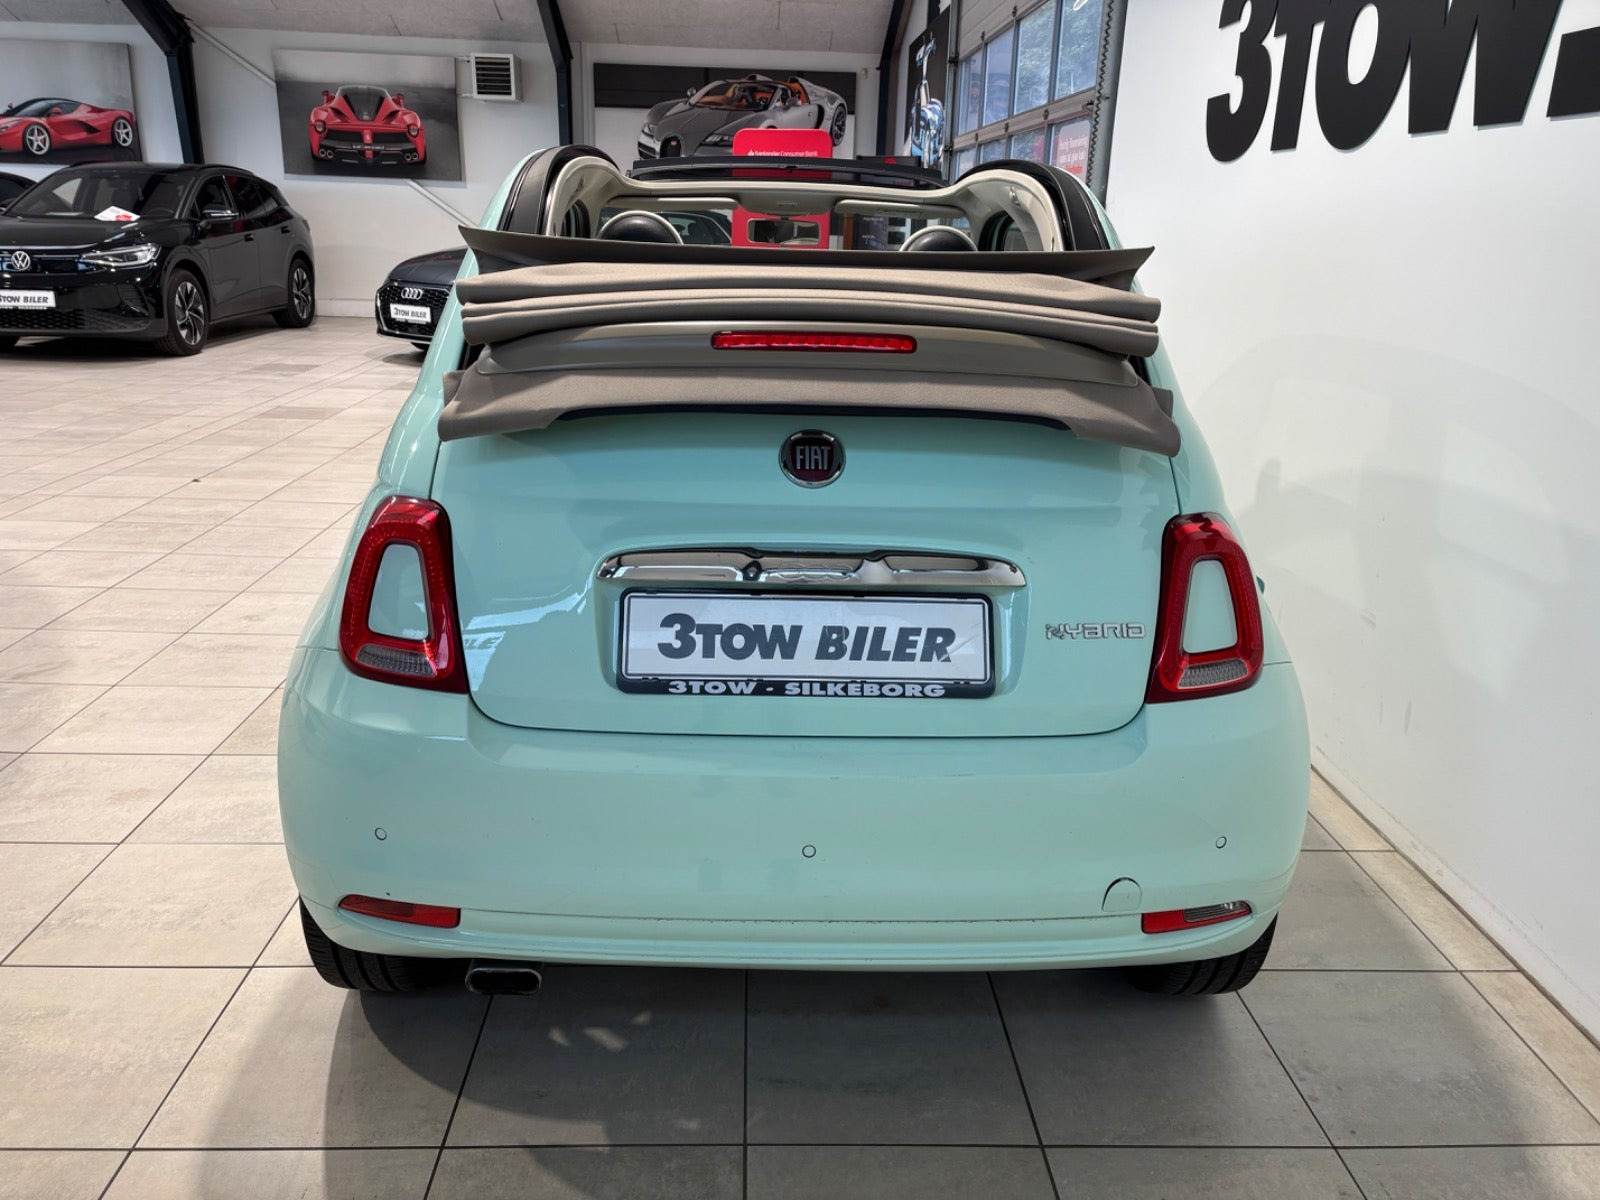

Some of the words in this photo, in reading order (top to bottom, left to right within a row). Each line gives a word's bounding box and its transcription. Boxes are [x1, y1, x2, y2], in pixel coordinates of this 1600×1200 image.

[796, 445, 831, 469] FIAT
[657, 612, 803, 660] 3TOW
[815, 625, 956, 662] BILER
[668, 680, 757, 694] 3TOW
[784, 682, 946, 697] SILKEBORG
